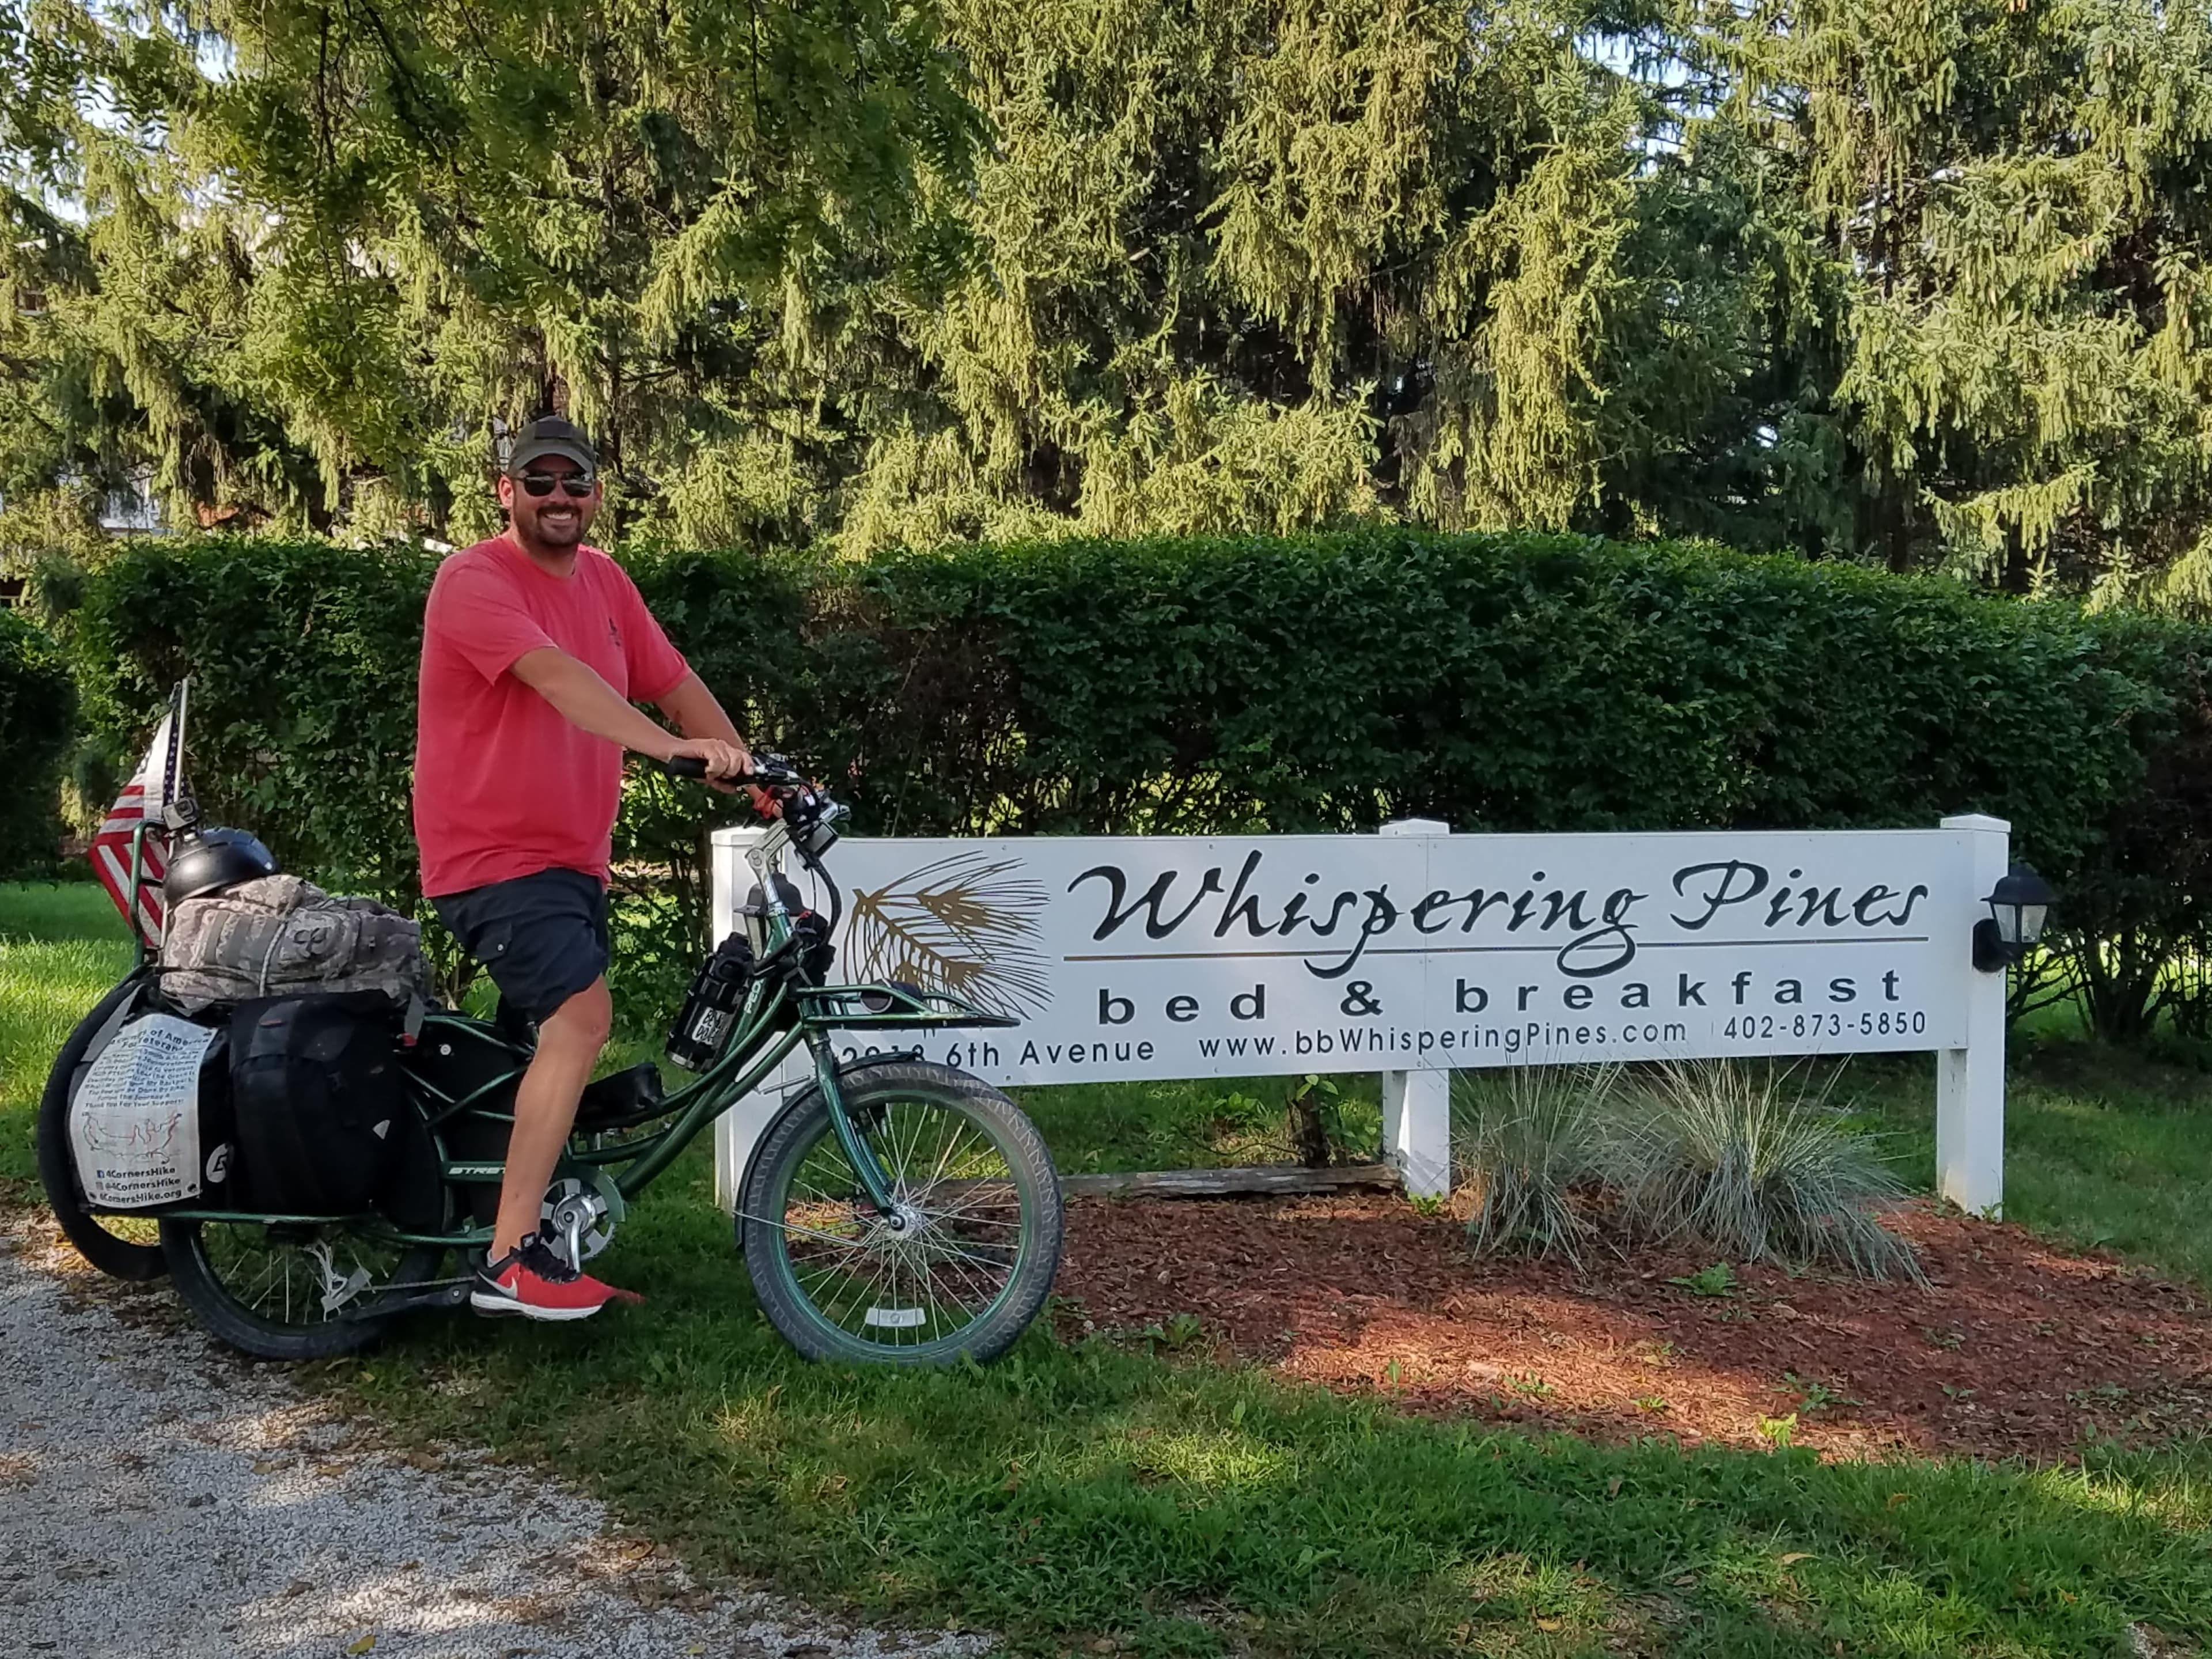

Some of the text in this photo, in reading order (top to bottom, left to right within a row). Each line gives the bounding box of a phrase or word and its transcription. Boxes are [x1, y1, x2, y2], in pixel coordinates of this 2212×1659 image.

[1067, 849, 1929, 979] Whispering Pines
[1099, 969, 1900, 1025] bed & breakfast
[946, 1041, 999, 1067] 6th
[1019, 1039, 1155, 1066] Avenue
[1198, 1022, 1686, 1058] www.bbWhisperingPines.com
[1724, 1010, 1926, 1039] 402-873-5850
